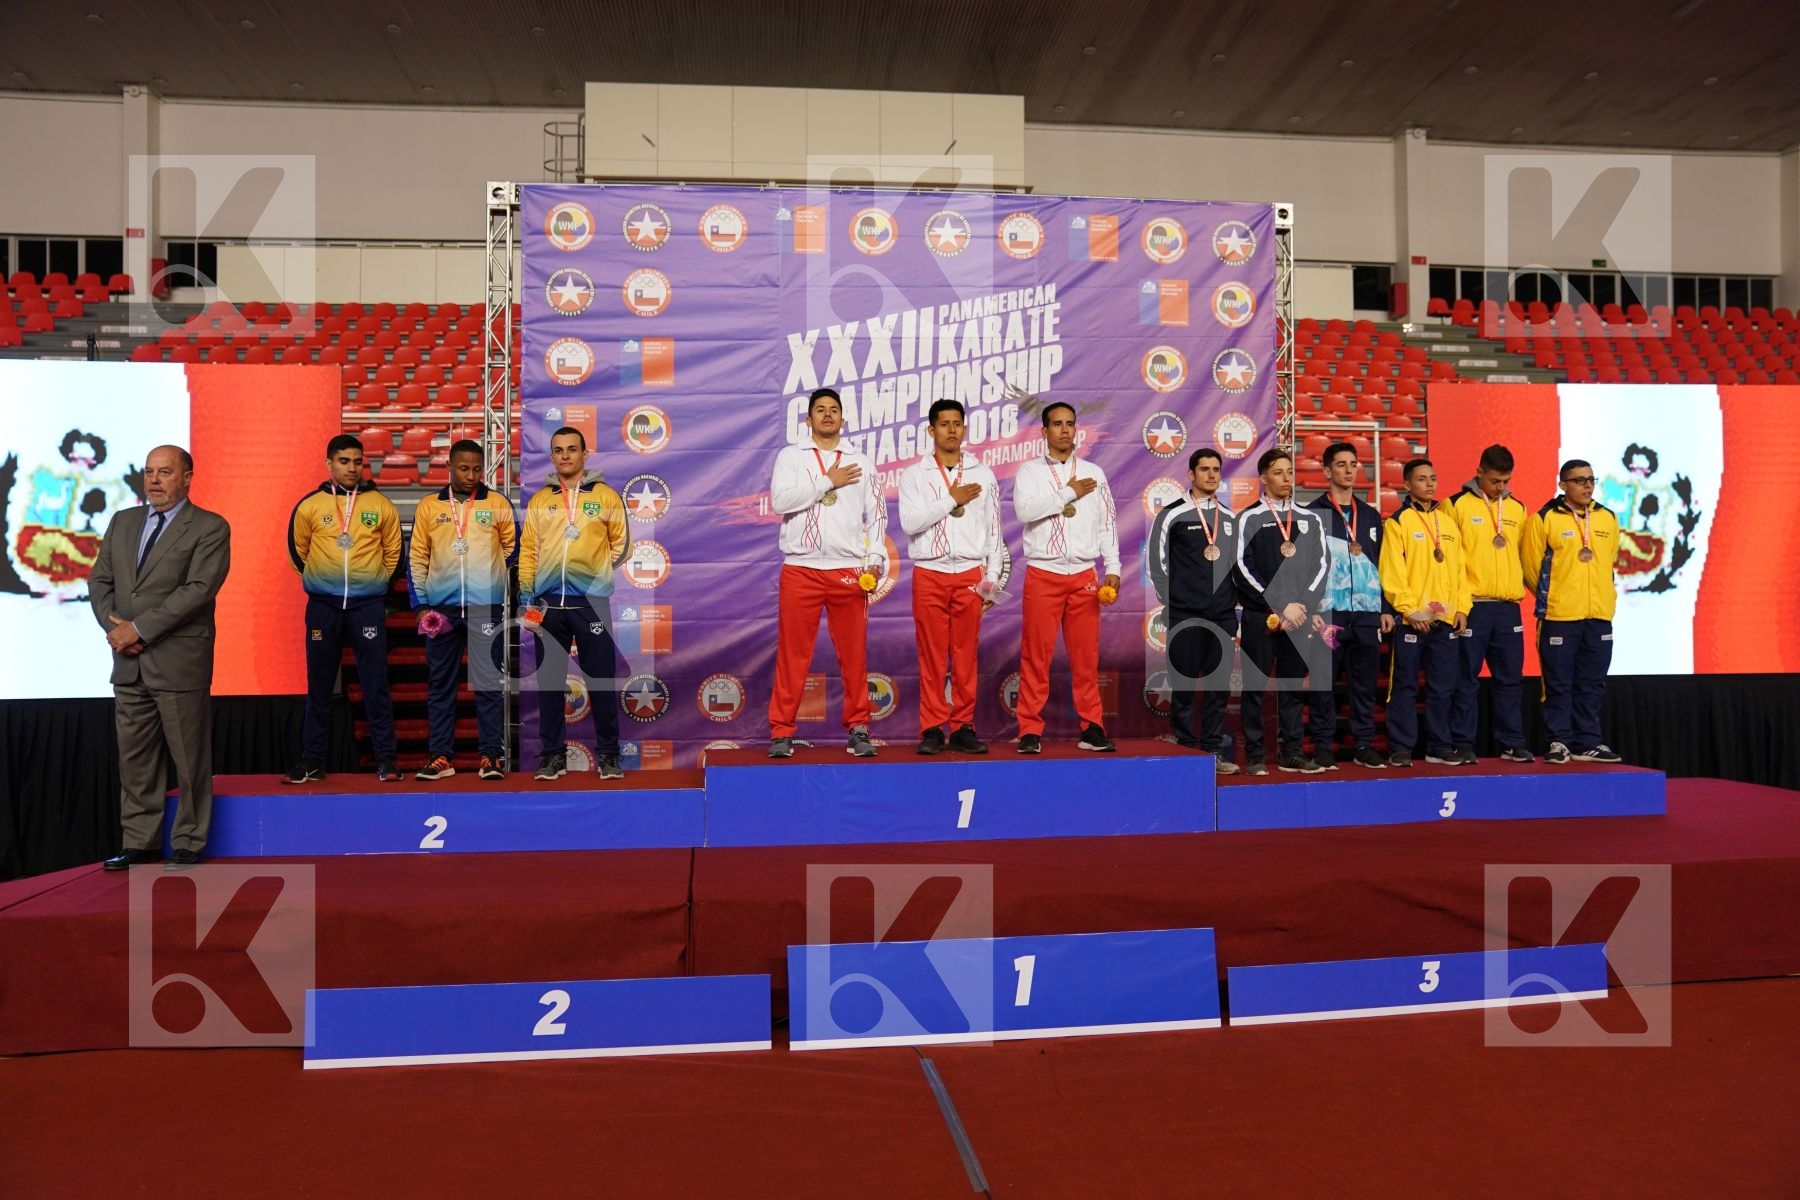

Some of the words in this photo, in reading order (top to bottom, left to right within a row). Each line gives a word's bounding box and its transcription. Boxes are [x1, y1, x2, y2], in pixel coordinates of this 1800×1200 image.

[939, 283, 1056, 324] PANAMERICAN
[783, 306, 935, 395] XXXII
[938, 302, 1061, 365] KARATE
[786, 344, 1063, 445] CAMPIONSHIP
[846, 421, 935, 466] TIAGO
[963, 404, 1018, 447] 018
[868, 578, 895, 603] ERATION
[957, 788, 976, 828] 1
[1438, 791, 1458, 818] 3
[419, 815, 448, 849] 2
[1014, 955, 1036, 1006] 1
[1418, 960, 1440, 993] 3
[532, 990, 571, 1036] 2
